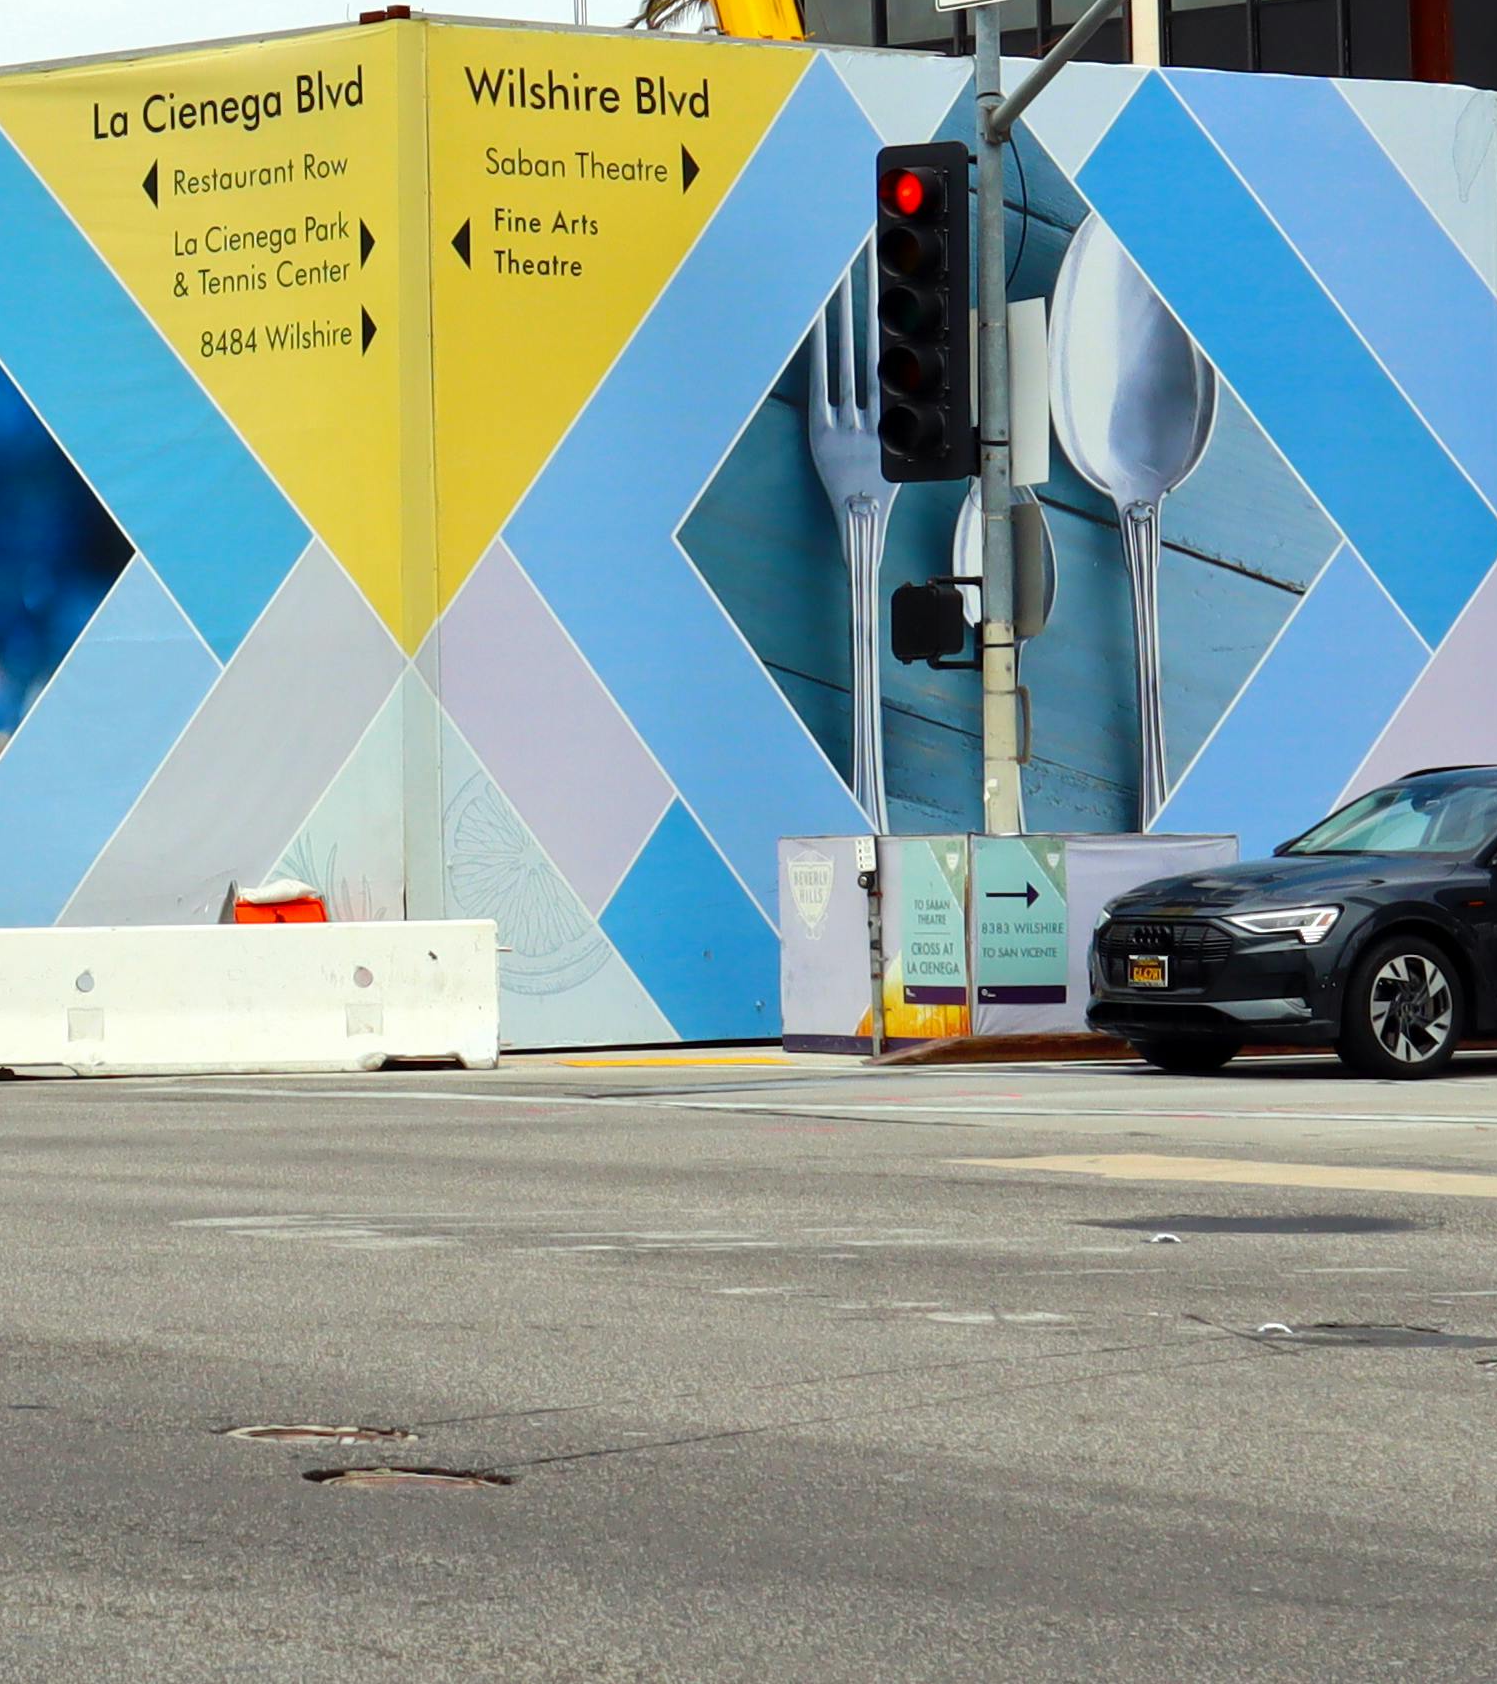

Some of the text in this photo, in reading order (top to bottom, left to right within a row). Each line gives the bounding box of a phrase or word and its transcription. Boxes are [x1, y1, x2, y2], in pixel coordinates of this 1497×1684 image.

[93, 64, 364, 140] La Cienega Blvd
[463, 66, 710, 119] Wilshire Blvd
[173, 153, 348, 196] Restaurant Row
[485, 147, 668, 183] Saban Theatre
[174, 211, 350, 256] La Cienega Park
[493, 207, 599, 236] Fine Arts
[493, 248, 583, 277] Theatre
[173, 259, 351, 298] & Tennis Center
[200, 319, 352, 358] 8484 Wilshire
[793, 870, 829, 886] BEVERLY
[799, 888, 824, 904] HILLS
[914, 899, 951, 911] TO SABAN
[917, 914, 947, 925] THEATRE
[981, 921, 1064, 935] 8383 WILSHIRE
[911, 942, 954, 956] CROSS AT
[982, 947, 1057, 958] TO SAN VICENTE
[907, 960, 961, 976] LA CIENEGA
